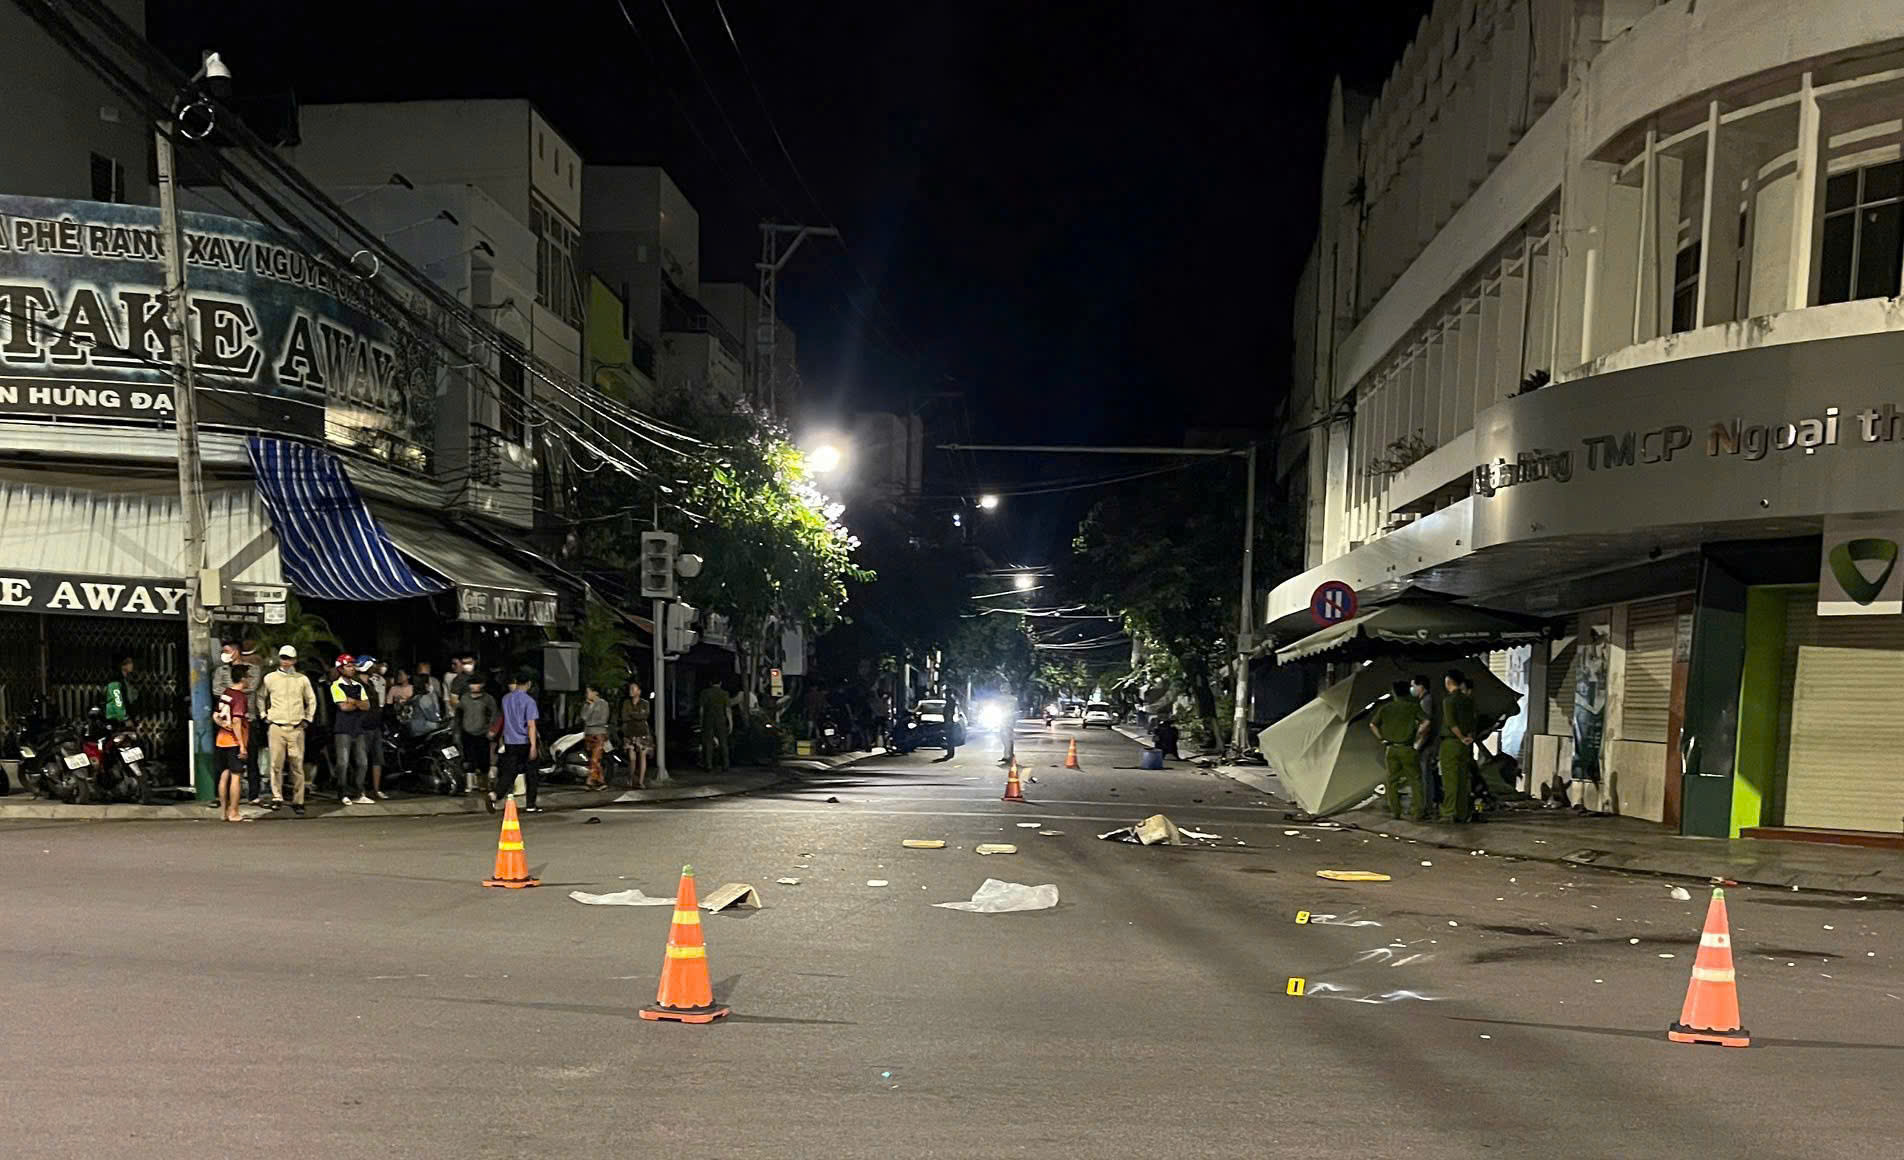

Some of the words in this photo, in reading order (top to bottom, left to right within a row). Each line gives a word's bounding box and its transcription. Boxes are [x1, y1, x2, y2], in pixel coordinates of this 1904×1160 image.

[15, 214, 84, 255] PHÊ
[186, 232, 250, 271] XAY
[0, 284, 262, 380] TAKE
[277, 314, 396, 408] AWAY
[29, 385, 121, 408] HƯNG
[130, 392, 175, 415] ĐẠ
[1582, 425, 1692, 471] TMCP
[1704, 407, 1839, 461] Ngoại
[46, 581, 188, 615] AWAY
